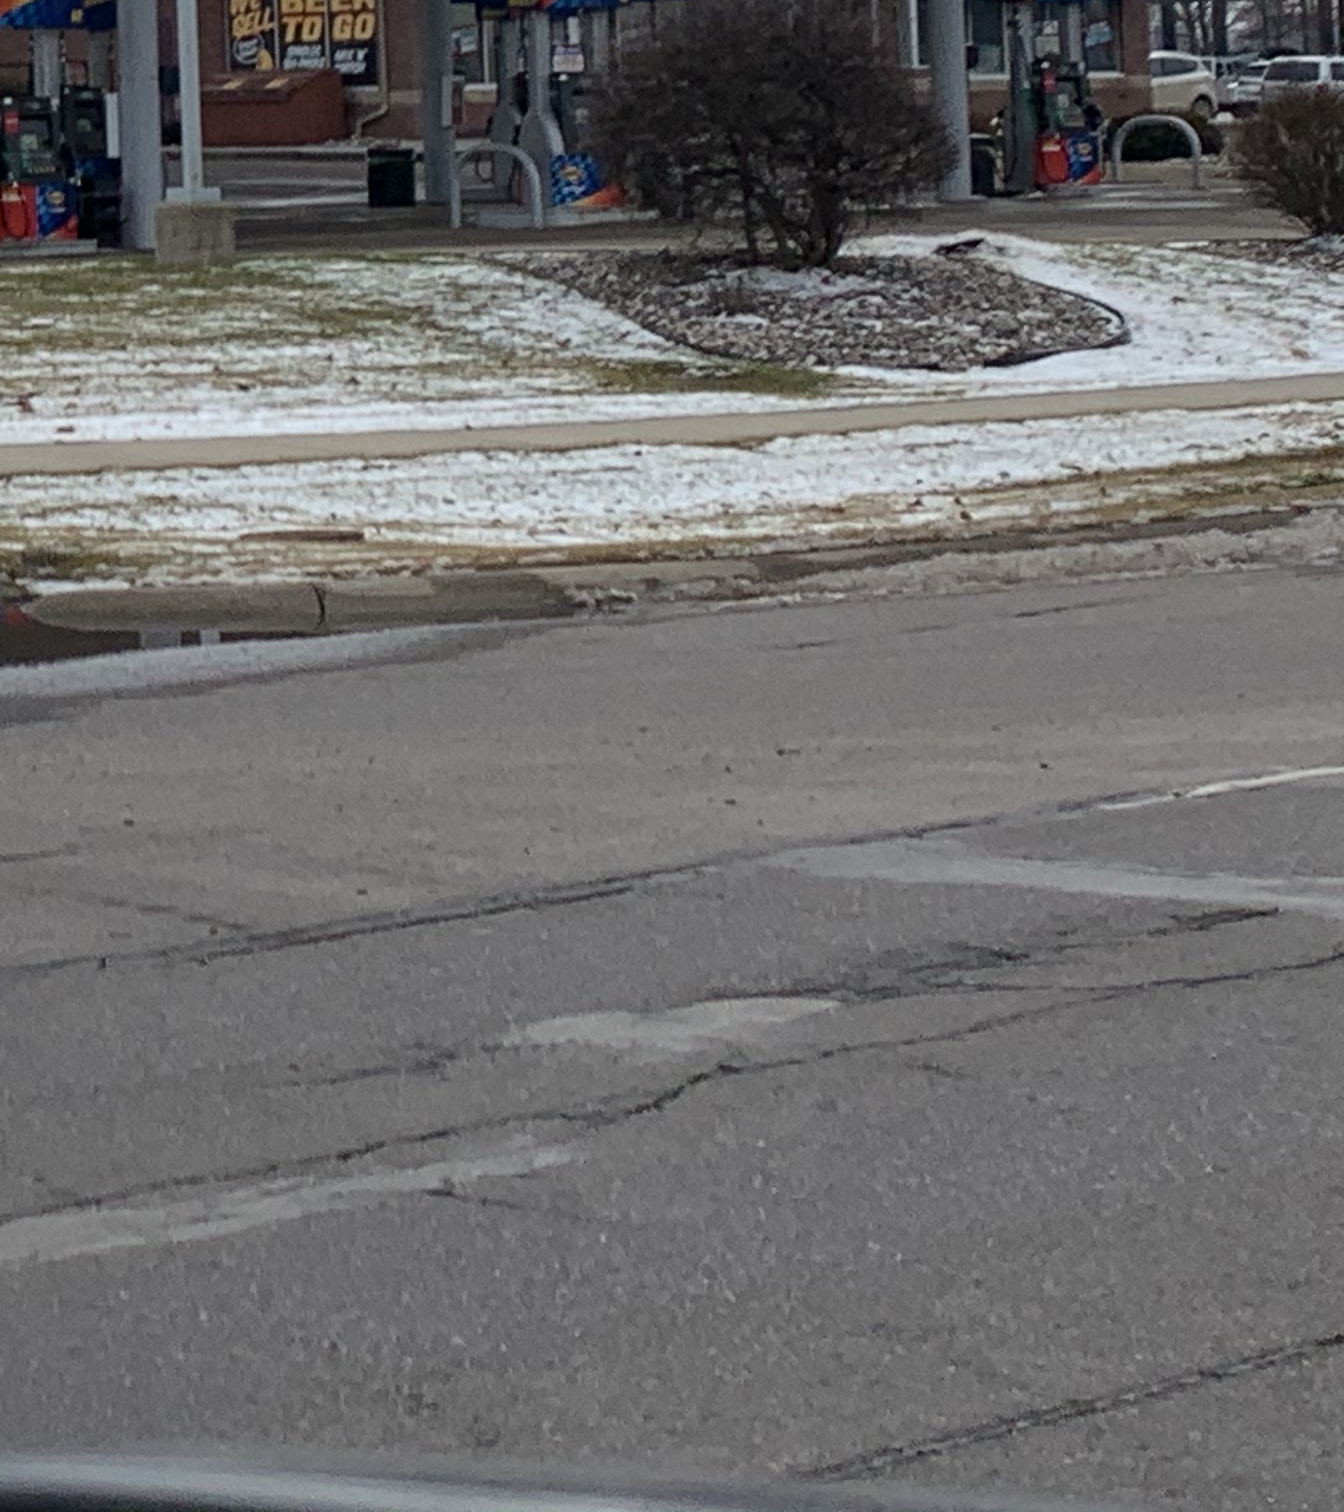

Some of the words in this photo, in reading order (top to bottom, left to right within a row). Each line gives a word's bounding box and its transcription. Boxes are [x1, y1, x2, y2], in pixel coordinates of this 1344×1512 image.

[231, 6, 274, 38] SELL
[281, 14, 323, 43] TO
[332, 12, 376, 41] GO
